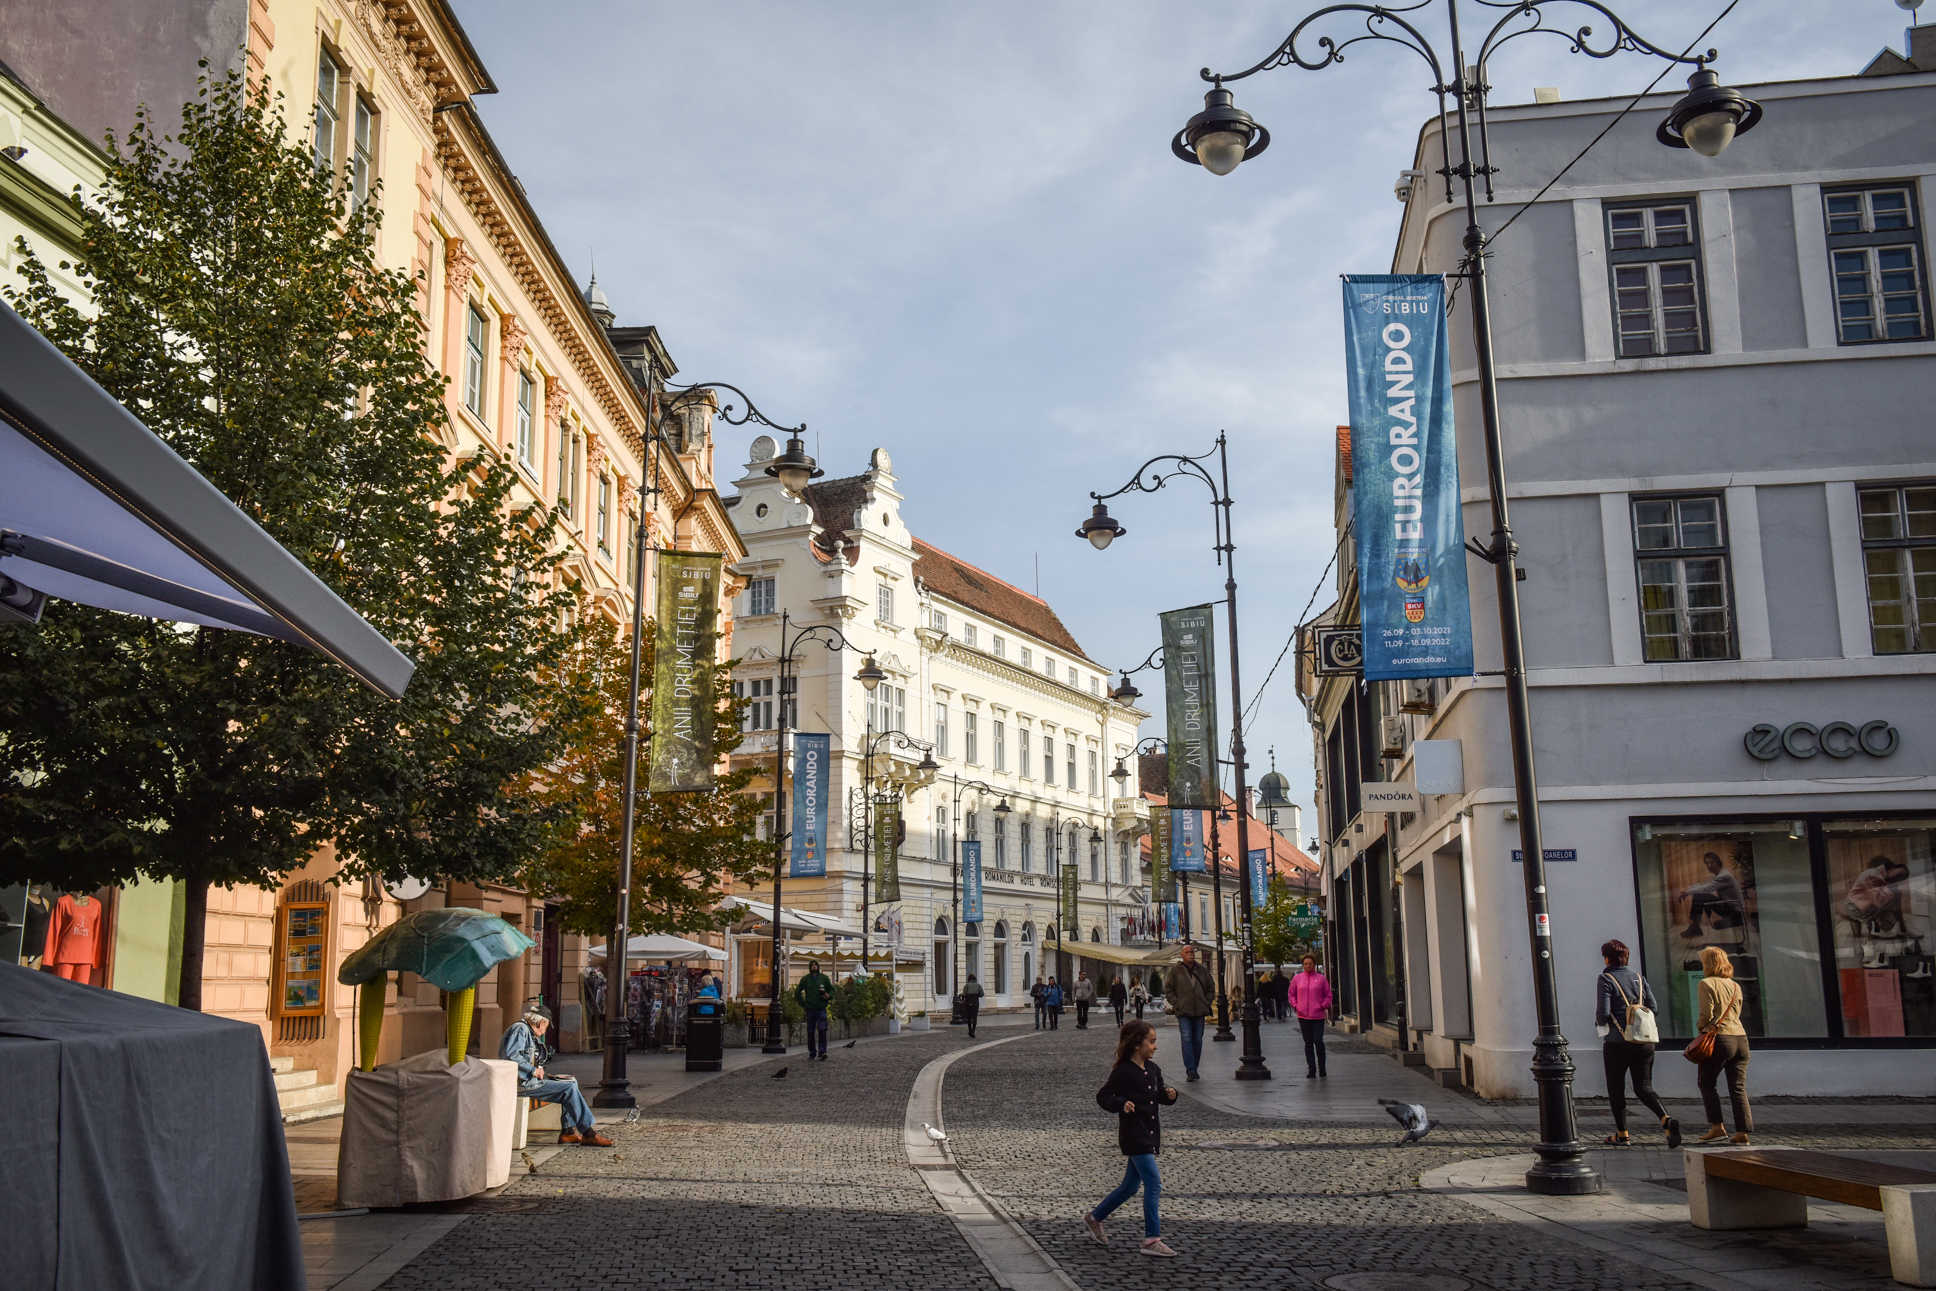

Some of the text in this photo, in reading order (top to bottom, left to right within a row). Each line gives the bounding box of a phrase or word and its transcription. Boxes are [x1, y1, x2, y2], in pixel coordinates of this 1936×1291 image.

[1383, 302, 1428, 314] SIBIU
[1382, 322, 1424, 540] EURORANDO
[682, 570, 711, 579] SIBIU
[678, 591, 699, 599] SIBIU
[1180, 620, 1205, 628] SIBIU
[1382, 629, 1403, 637] 26.09
[1411, 627, 1451, 635] 03.10.2021
[1384, 640, 1403, 648] 11.09
[1411, 638, 1450, 646] 18.09.2022
[674, 606, 699, 698] DRUMEȚIEI
[1392, 657, 1447, 665] eurorando.eu
[673, 707, 692, 742] ANII
[1743, 719, 1900, 760] ecco
[1186, 738, 1201, 768] ANII
[1422, 778, 1458, 789] ecco
[806, 750, 818, 830] EURORANDO
[1368, 791, 1413, 801] PANDORA
[1515, 851, 1523, 860] St
[969, 850, 977, 896] EURORANDO
[984, 871, 1015, 885] ROMANILOR
[1020, 876, 1035, 886] HOTEL
